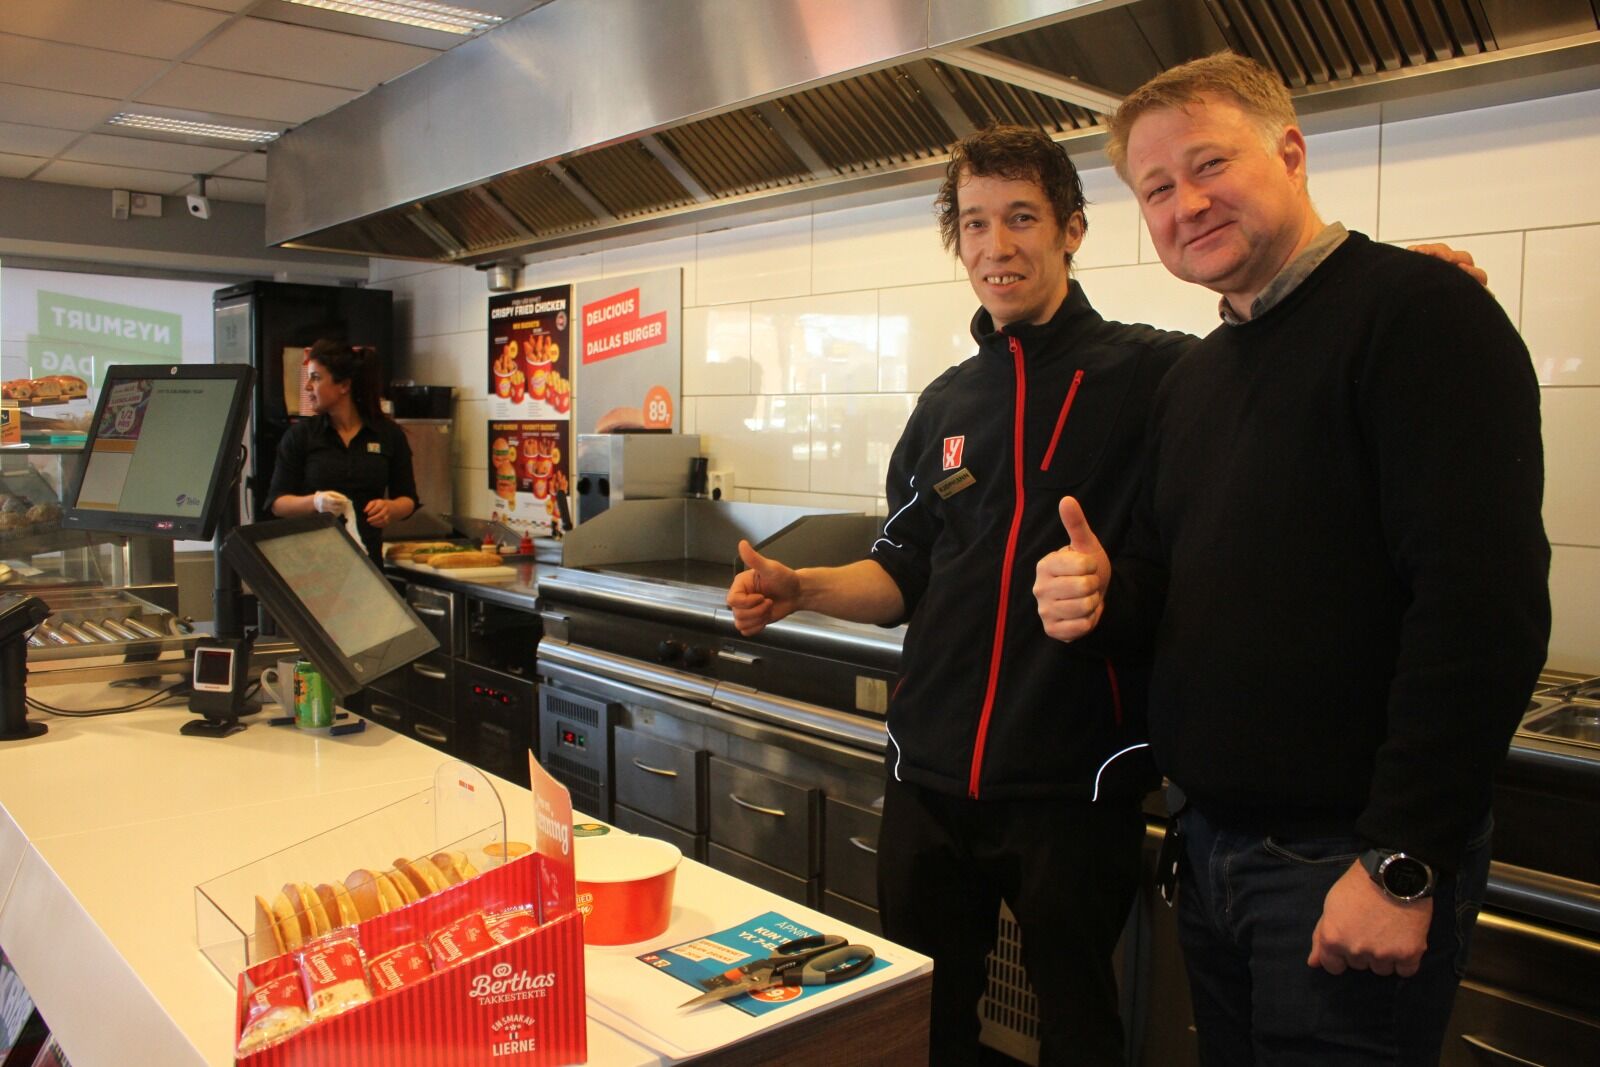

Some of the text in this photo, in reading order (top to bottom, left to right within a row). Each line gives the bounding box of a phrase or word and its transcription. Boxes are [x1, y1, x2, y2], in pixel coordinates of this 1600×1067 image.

[491, 306, 515, 319] CRISPY
[514, 304, 534, 316] FRIED
[534, 299, 566, 313] CHICKEN
[587, 299, 634, 327] DELICIOUS
[587, 322, 662, 356] DALLAS BURGER
[753, 927, 781, 941] KUN
[468, 970, 556, 998] Berthas
[478, 989, 546, 1006] TAKKESTEKTE
[492, 1038, 536, 1057] LIERNE
